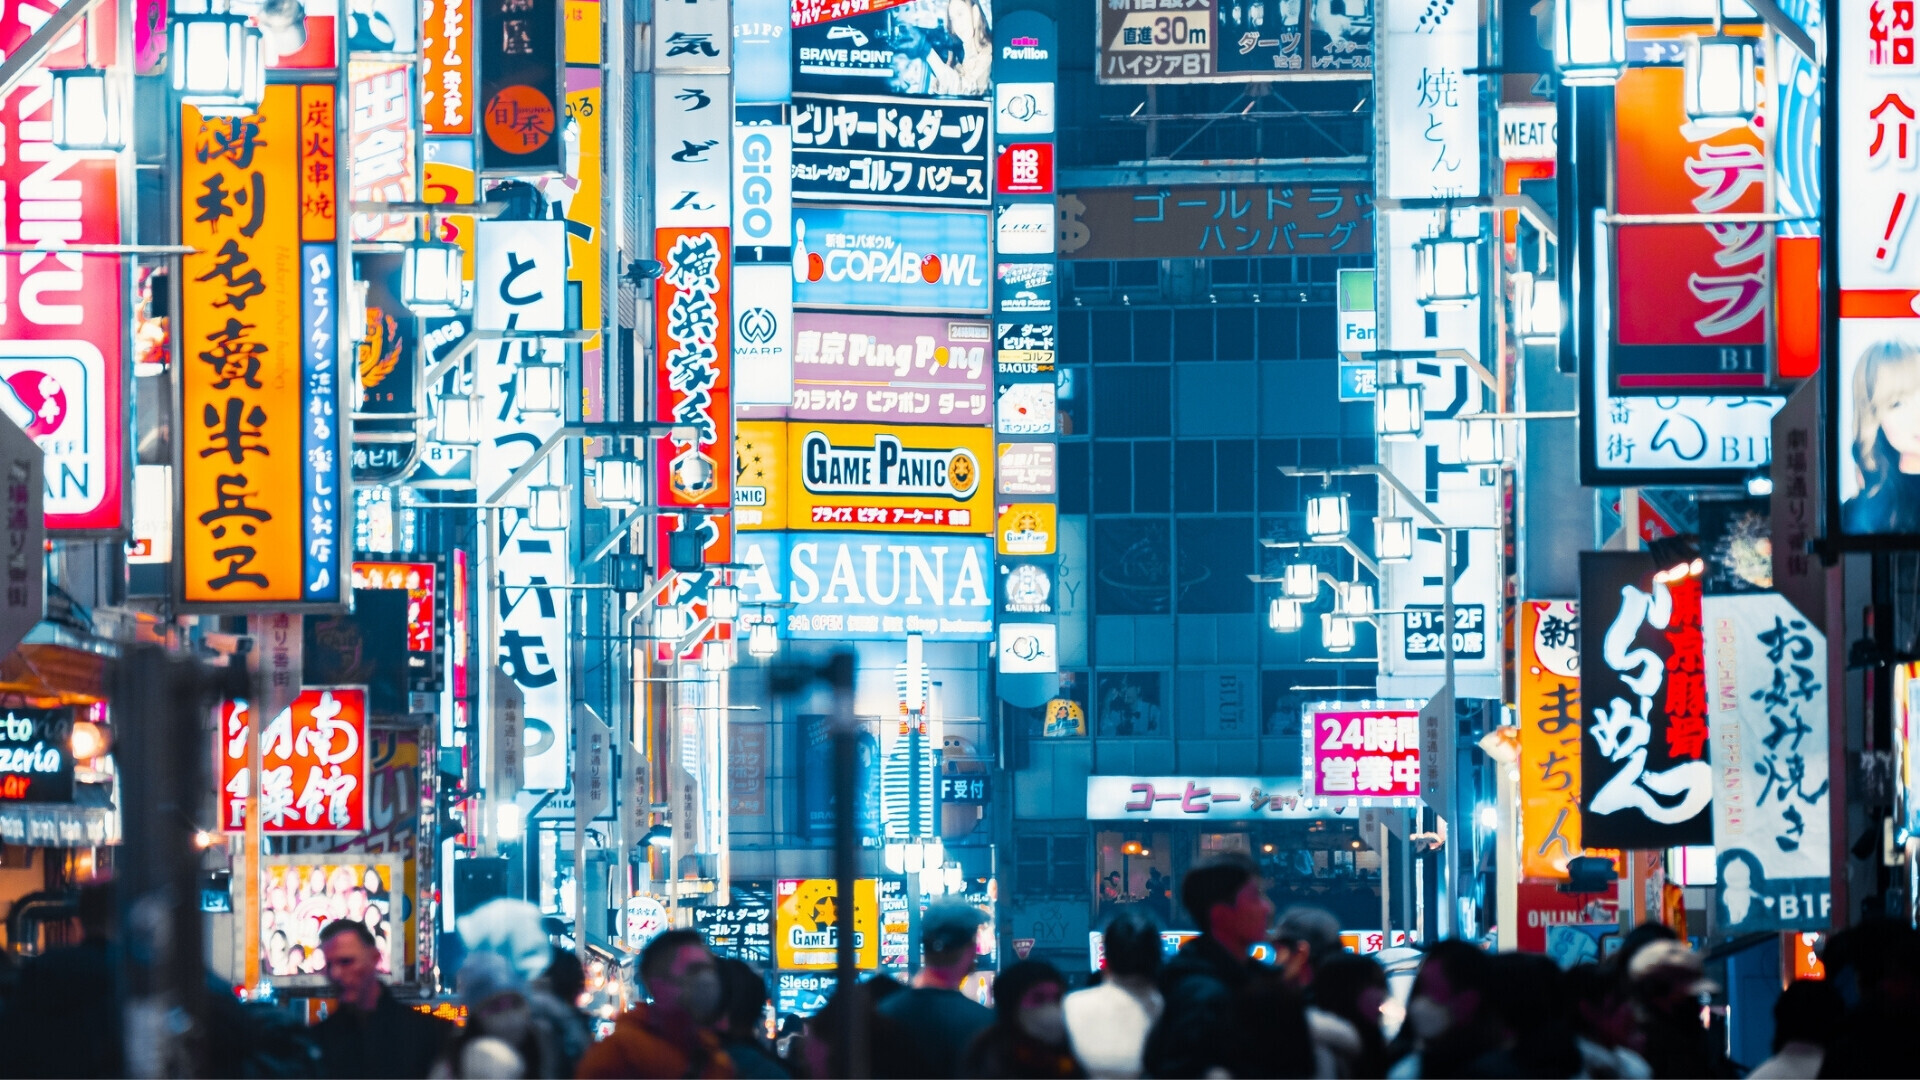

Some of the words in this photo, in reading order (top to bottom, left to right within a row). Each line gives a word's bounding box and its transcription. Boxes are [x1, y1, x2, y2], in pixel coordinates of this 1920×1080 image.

[800, 47, 848, 62] BRAVE
[850, 49, 893, 63] POINT
[1002, 46, 1049, 61] Pavilion
[1238, 31, 1301, 55] ダーツ
[1107, 52, 1211, 76] ハイジアB1
[1273, 54, 1302, 69] 12台
[486, 95, 554, 147] 旬香
[791, 103, 984, 153] ビリヤード&ダーツ
[1503, 121, 1546, 146] MEAT
[301, 100, 333, 219] 炭火串焼
[1012, 149, 1039, 163] MO
[917, 165, 985, 194] バグース
[1012, 165, 1039, 178] MO
[742, 133, 773, 238] GiGO
[1133, 188, 1374, 223] ゴールドラッ
[1199, 221, 1358, 251] ハンバーグ
[753, 246, 763, 261] 1
[824, 243, 983, 287] COPABOWL
[1020, 324, 1053, 338] ダーツ
[734, 345, 783, 356] WARP
[1003, 337, 1054, 351] ビリヤード
[999, 364, 1038, 374] BAGUS
[1022, 352, 1053, 362] ゴルフ
[1719, 348, 1755, 371] B1
[793, 389, 858, 411] カラオケ
[938, 393, 987, 416] ダーツ
[431, 448, 457, 461] B1
[735, 489, 763, 504] ANIC
[811, 506, 853, 522] プライズ
[789, 541, 992, 607] SAUNA
[1219, 674, 1238, 732] BLUE
[1320, 714, 1420, 753] 24時間
[1750, 615, 1830, 853] お好み焼き
[0, 741, 61, 773] zeria
[1320, 754, 1421, 792] 営業中
[1125, 782, 1241, 814] コーヒー
[779, 973, 819, 991] Sleep
